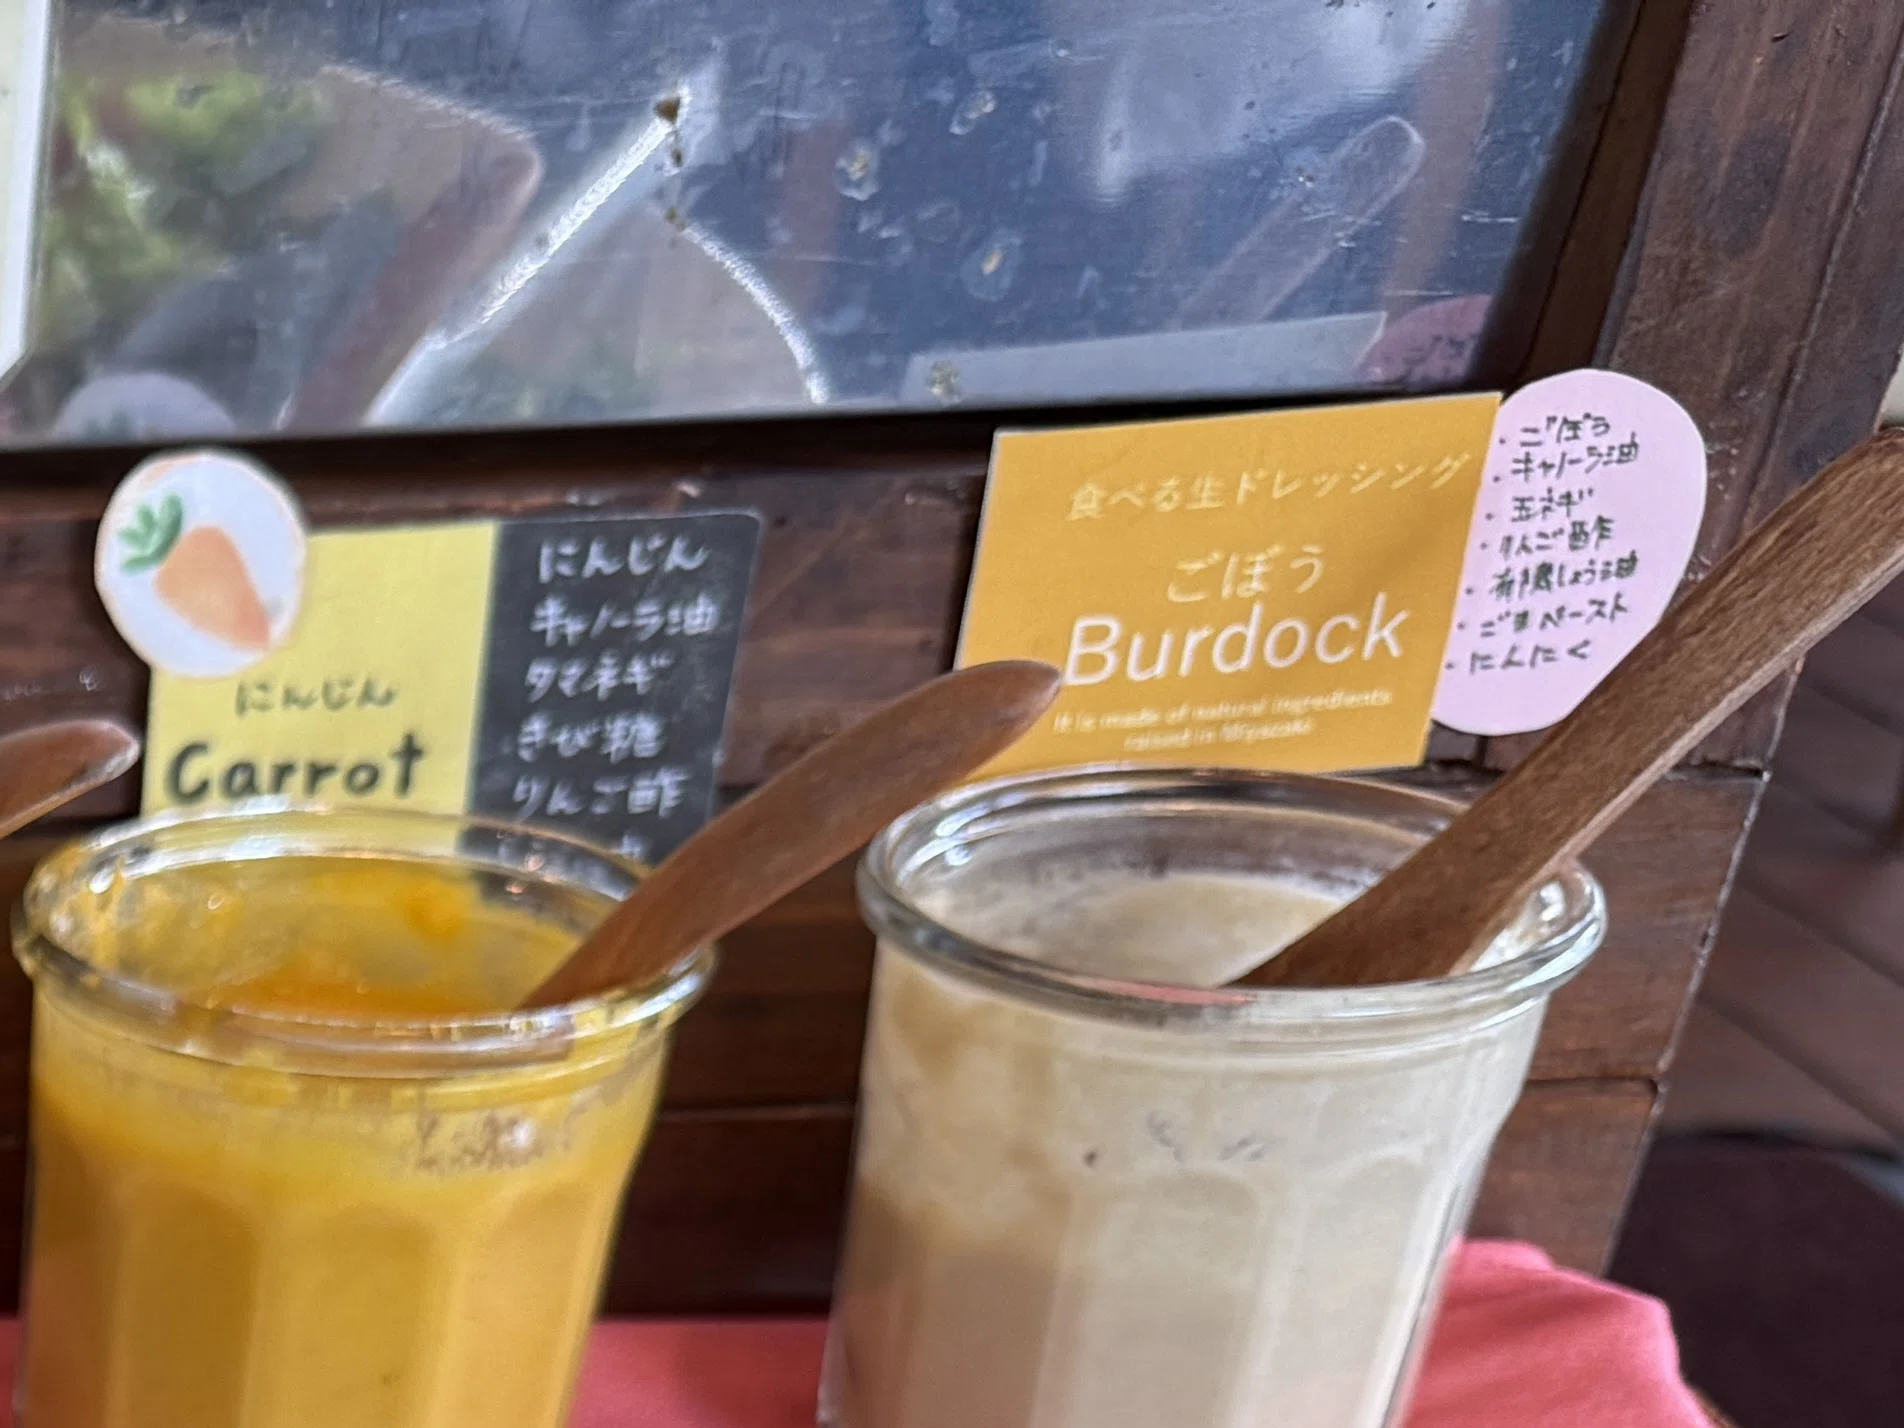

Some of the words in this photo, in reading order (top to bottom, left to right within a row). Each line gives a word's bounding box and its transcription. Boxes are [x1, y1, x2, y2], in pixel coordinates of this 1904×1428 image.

[1512, 432, 1640, 483] キャノーラ油
[1065, 452, 1472, 521] 食べる生ドレッシング
[539, 533, 710, 585] にんじん
[1167, 545, 1325, 603] ごぼう
[530, 594, 721, 649] キャノーラ油
[1063, 592, 1412, 688] Burdock
[525, 652, 675, 702] タマネギ
[1469, 640, 1592, 676] にんにく
[235, 675, 398, 718] にんじん
[166, 731, 426, 804] Carrot
